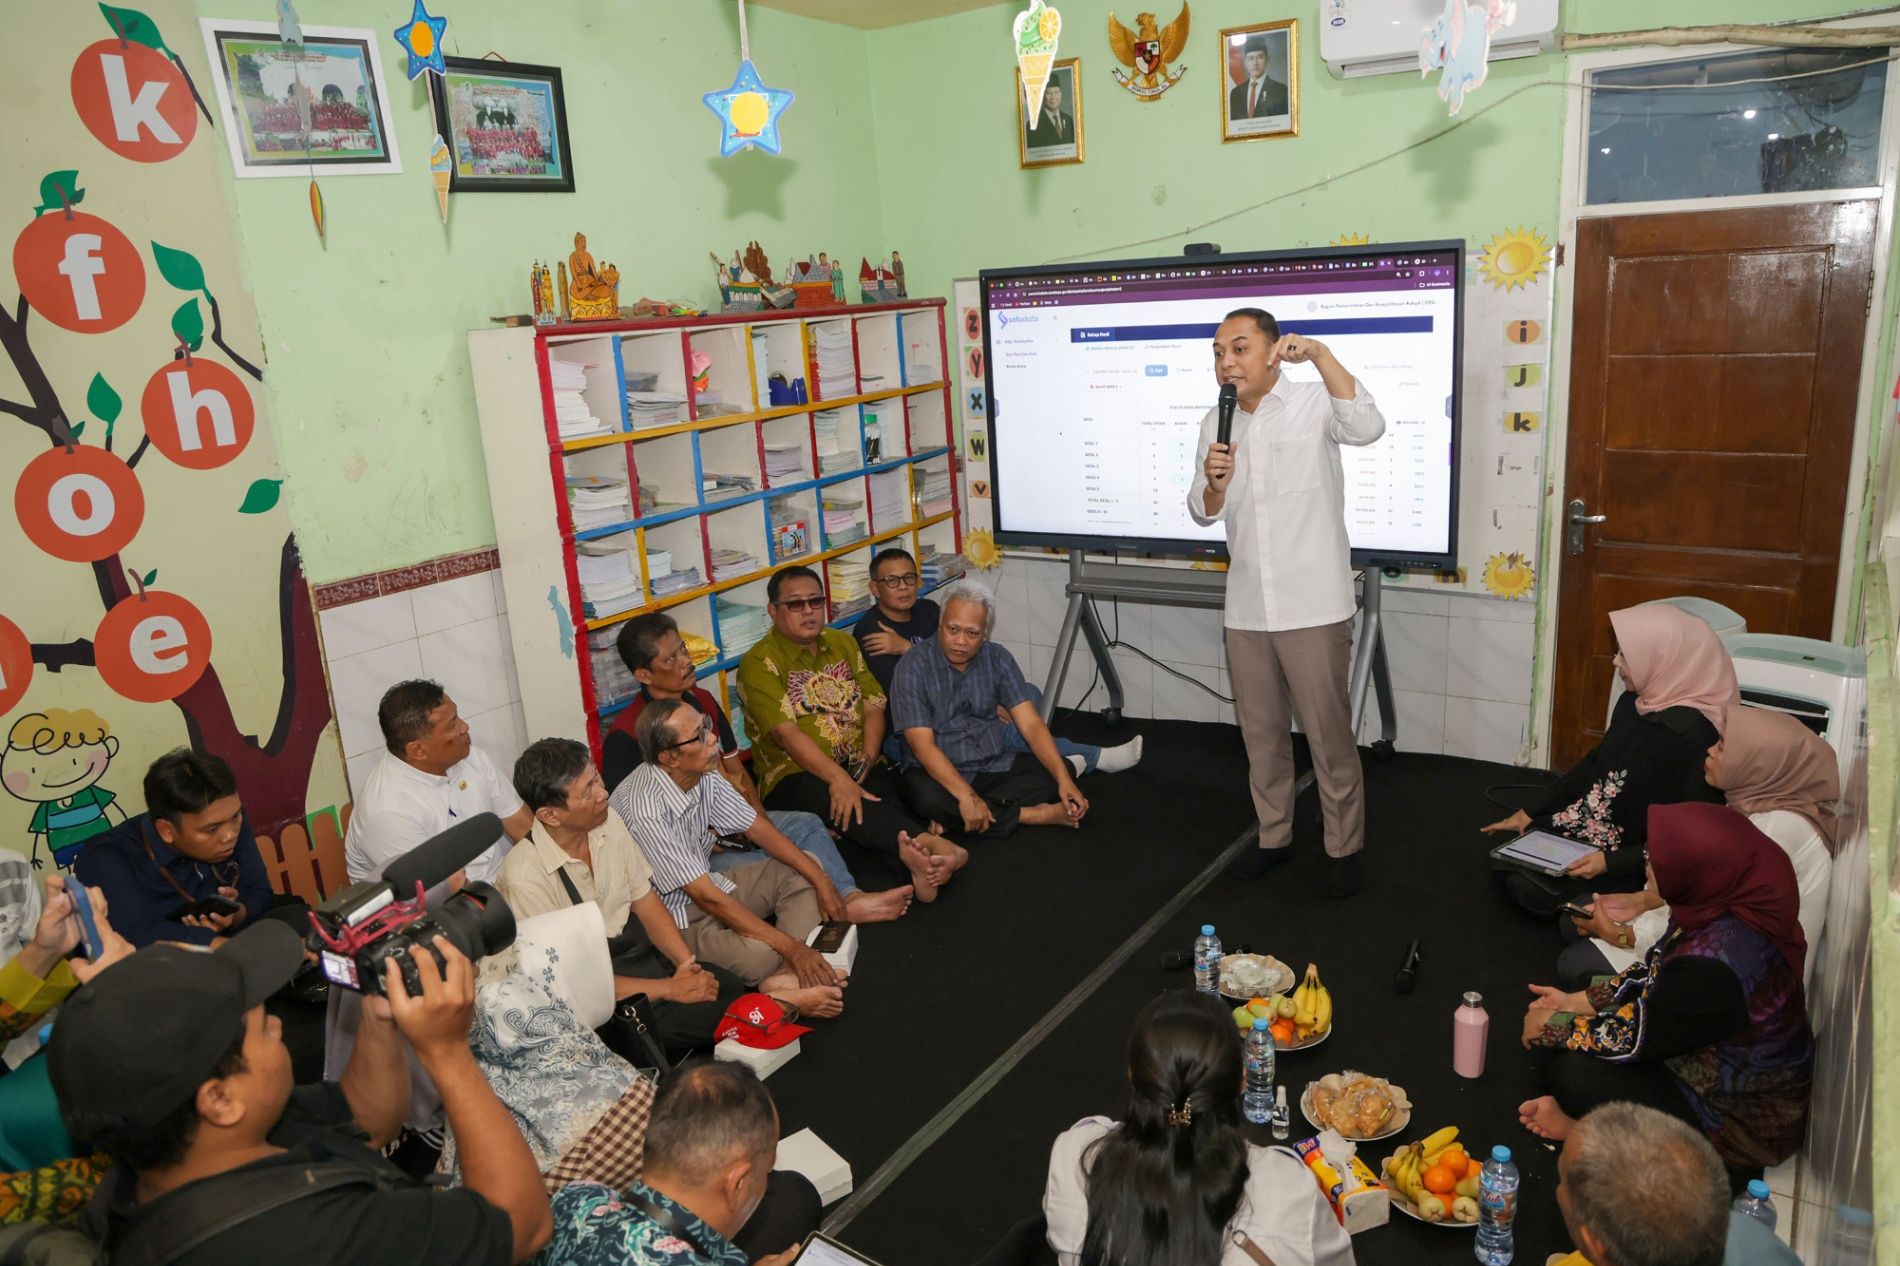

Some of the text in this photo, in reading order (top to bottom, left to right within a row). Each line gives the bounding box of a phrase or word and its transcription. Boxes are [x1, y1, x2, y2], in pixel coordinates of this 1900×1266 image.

[100, 53, 184, 144] k
[57, 233, 106, 320] f
[1519, 320, 1528, 342] i
[166, 370, 237, 452] h
[1513, 412, 1532, 432] k
[47, 473, 115, 536] o
[129, 615, 188, 676] e
